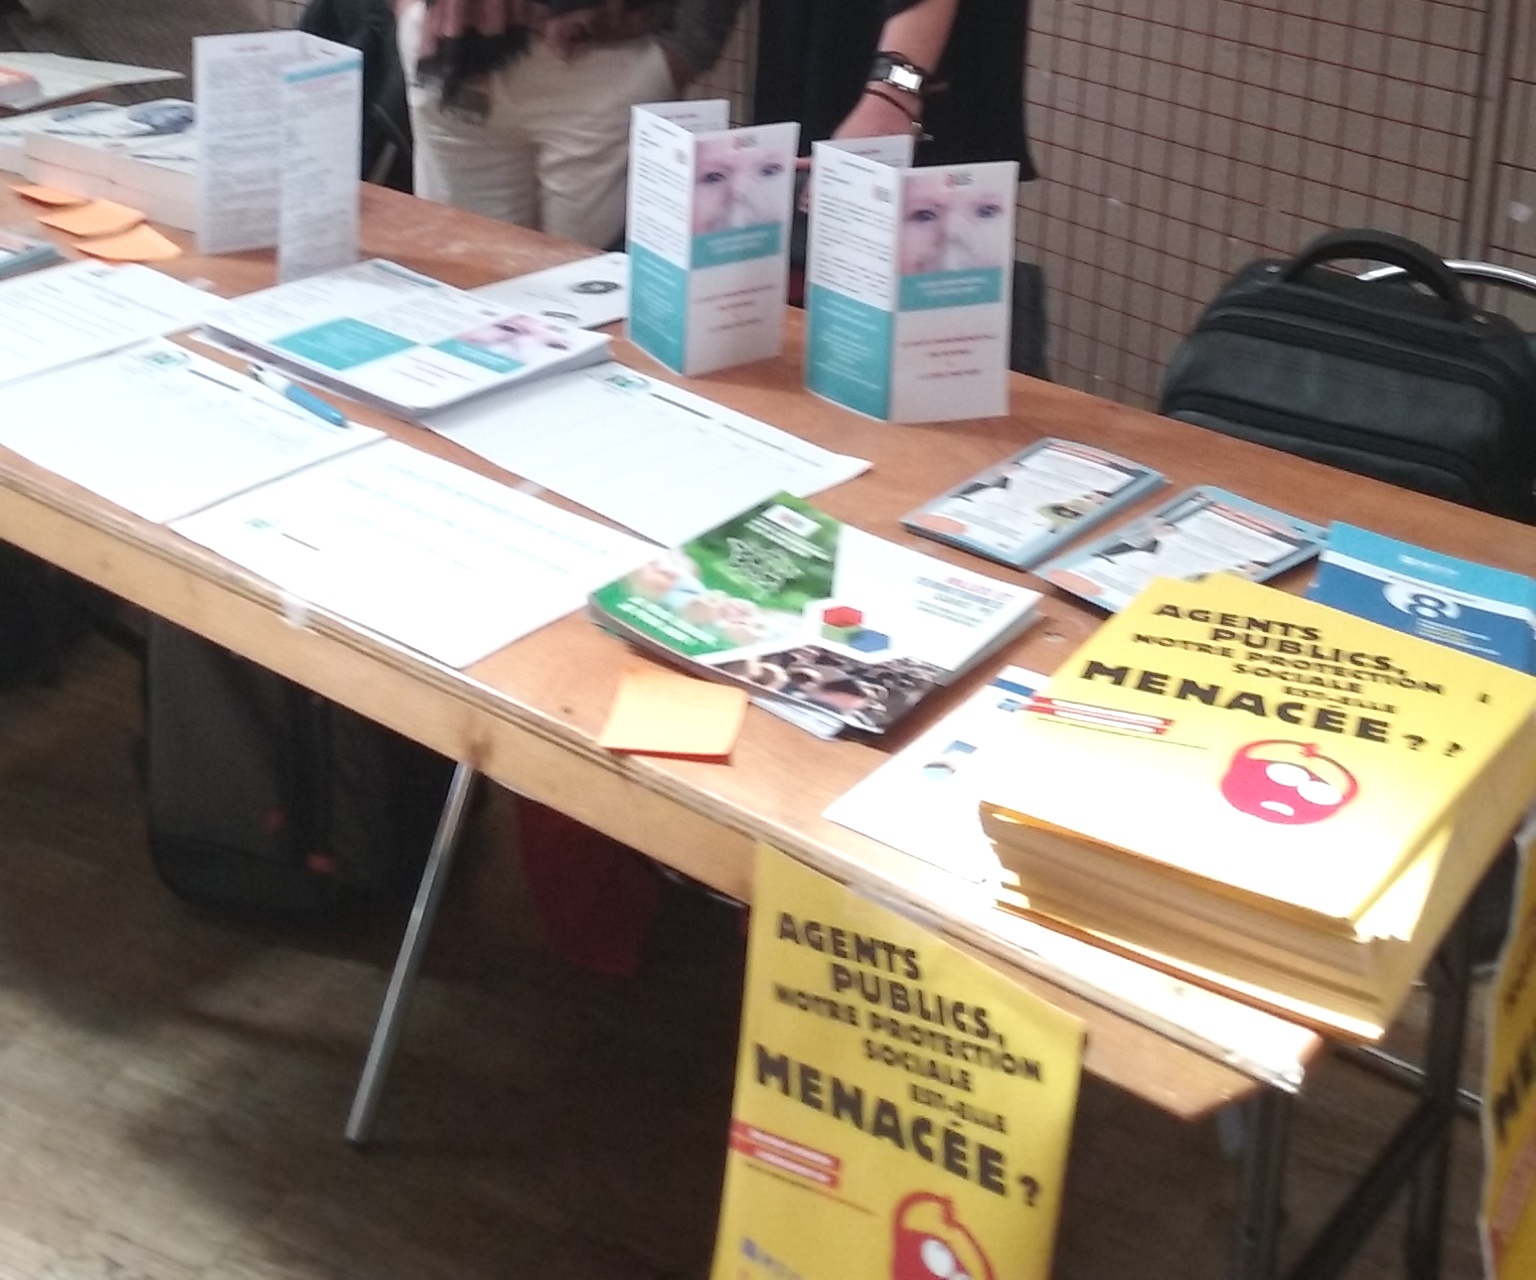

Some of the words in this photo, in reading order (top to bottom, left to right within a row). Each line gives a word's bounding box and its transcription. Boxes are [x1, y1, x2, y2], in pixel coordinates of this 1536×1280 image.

[1152, 603, 1321, 641] AGENTS
[1407, 593, 1447, 620] 8
[1131, 632, 1234, 658] NOTRE
[1245, 650, 1442, 695] PROTECTION
[1211, 627, 1409, 676] PUBLICS,
[1233, 663, 1363, 694] SOCIALE
[1080, 660, 1389, 743] MENACÉE
[778, 912, 919, 980] AGENTS
[775, 984, 858, 1026] NOTRE
[869, 1012, 1042, 1081] PROTECTION
[829, 962, 1006, 1046] PUBLICS,
[864, 1038, 973, 1092] SOCIALE
[754, 1043, 1007, 1196] MENACÉE
[1018, 1174, 1041, 1207] ?
